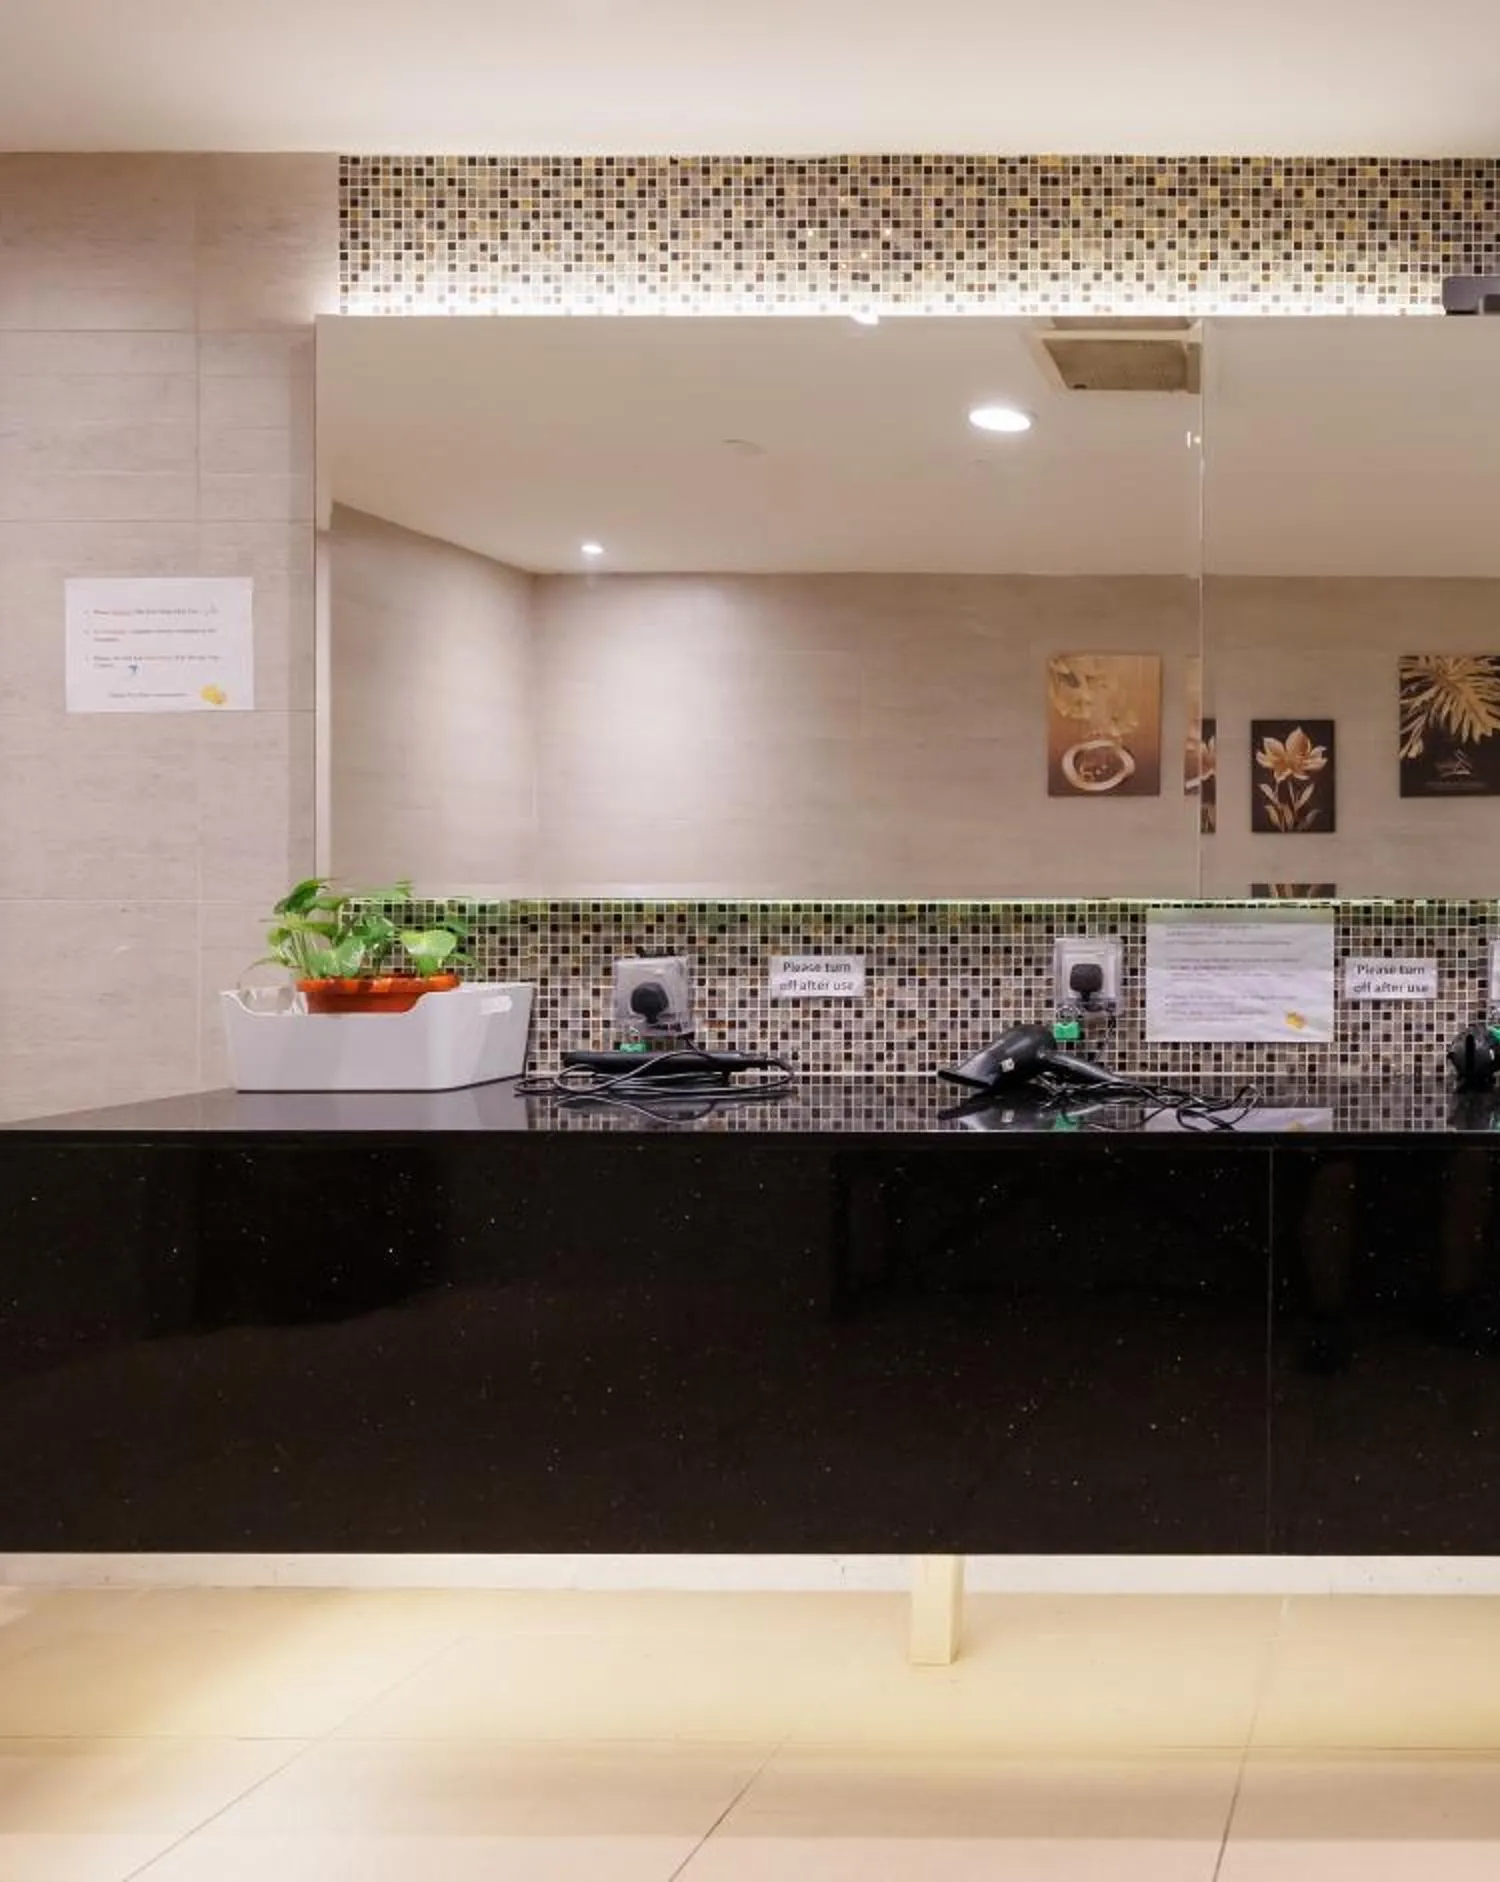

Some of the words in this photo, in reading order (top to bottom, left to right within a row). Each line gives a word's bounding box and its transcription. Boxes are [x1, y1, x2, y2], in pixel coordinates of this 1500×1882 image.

[783, 961, 821, 973] Please
[825, 962, 852, 973] turn
[1357, 964, 1397, 975] Please
[1399, 965, 1425, 975] turn
[779, 979, 797, 991] off
[799, 979, 829, 991] after
[833, 981, 855, 991] use
[1353, 981, 1371, 993] off
[1374, 981, 1403, 993] after
[1407, 984, 1429, 993] use
